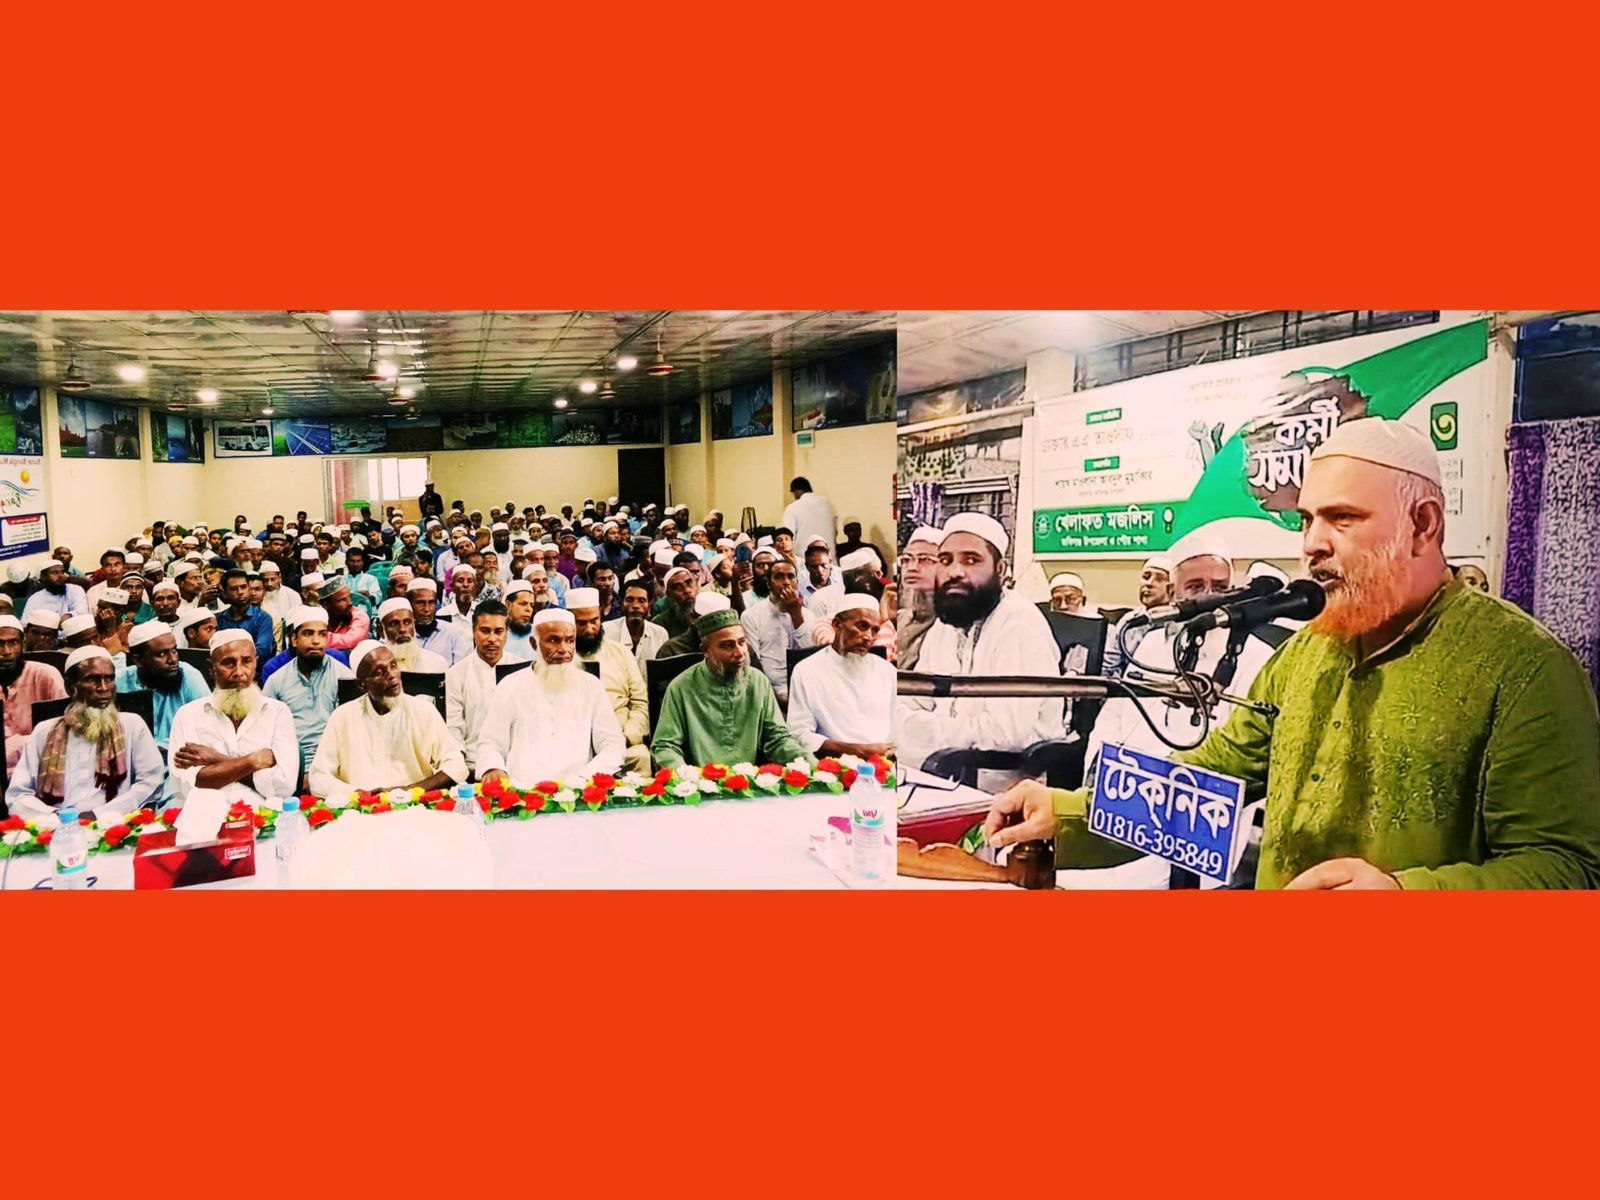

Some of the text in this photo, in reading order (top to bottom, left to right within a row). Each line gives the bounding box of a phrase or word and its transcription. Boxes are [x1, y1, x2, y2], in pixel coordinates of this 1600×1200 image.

[1055, 504, 1155, 533] খেলাফত মজলিস
[1093, 808, 1223, 876] 01816-395849
